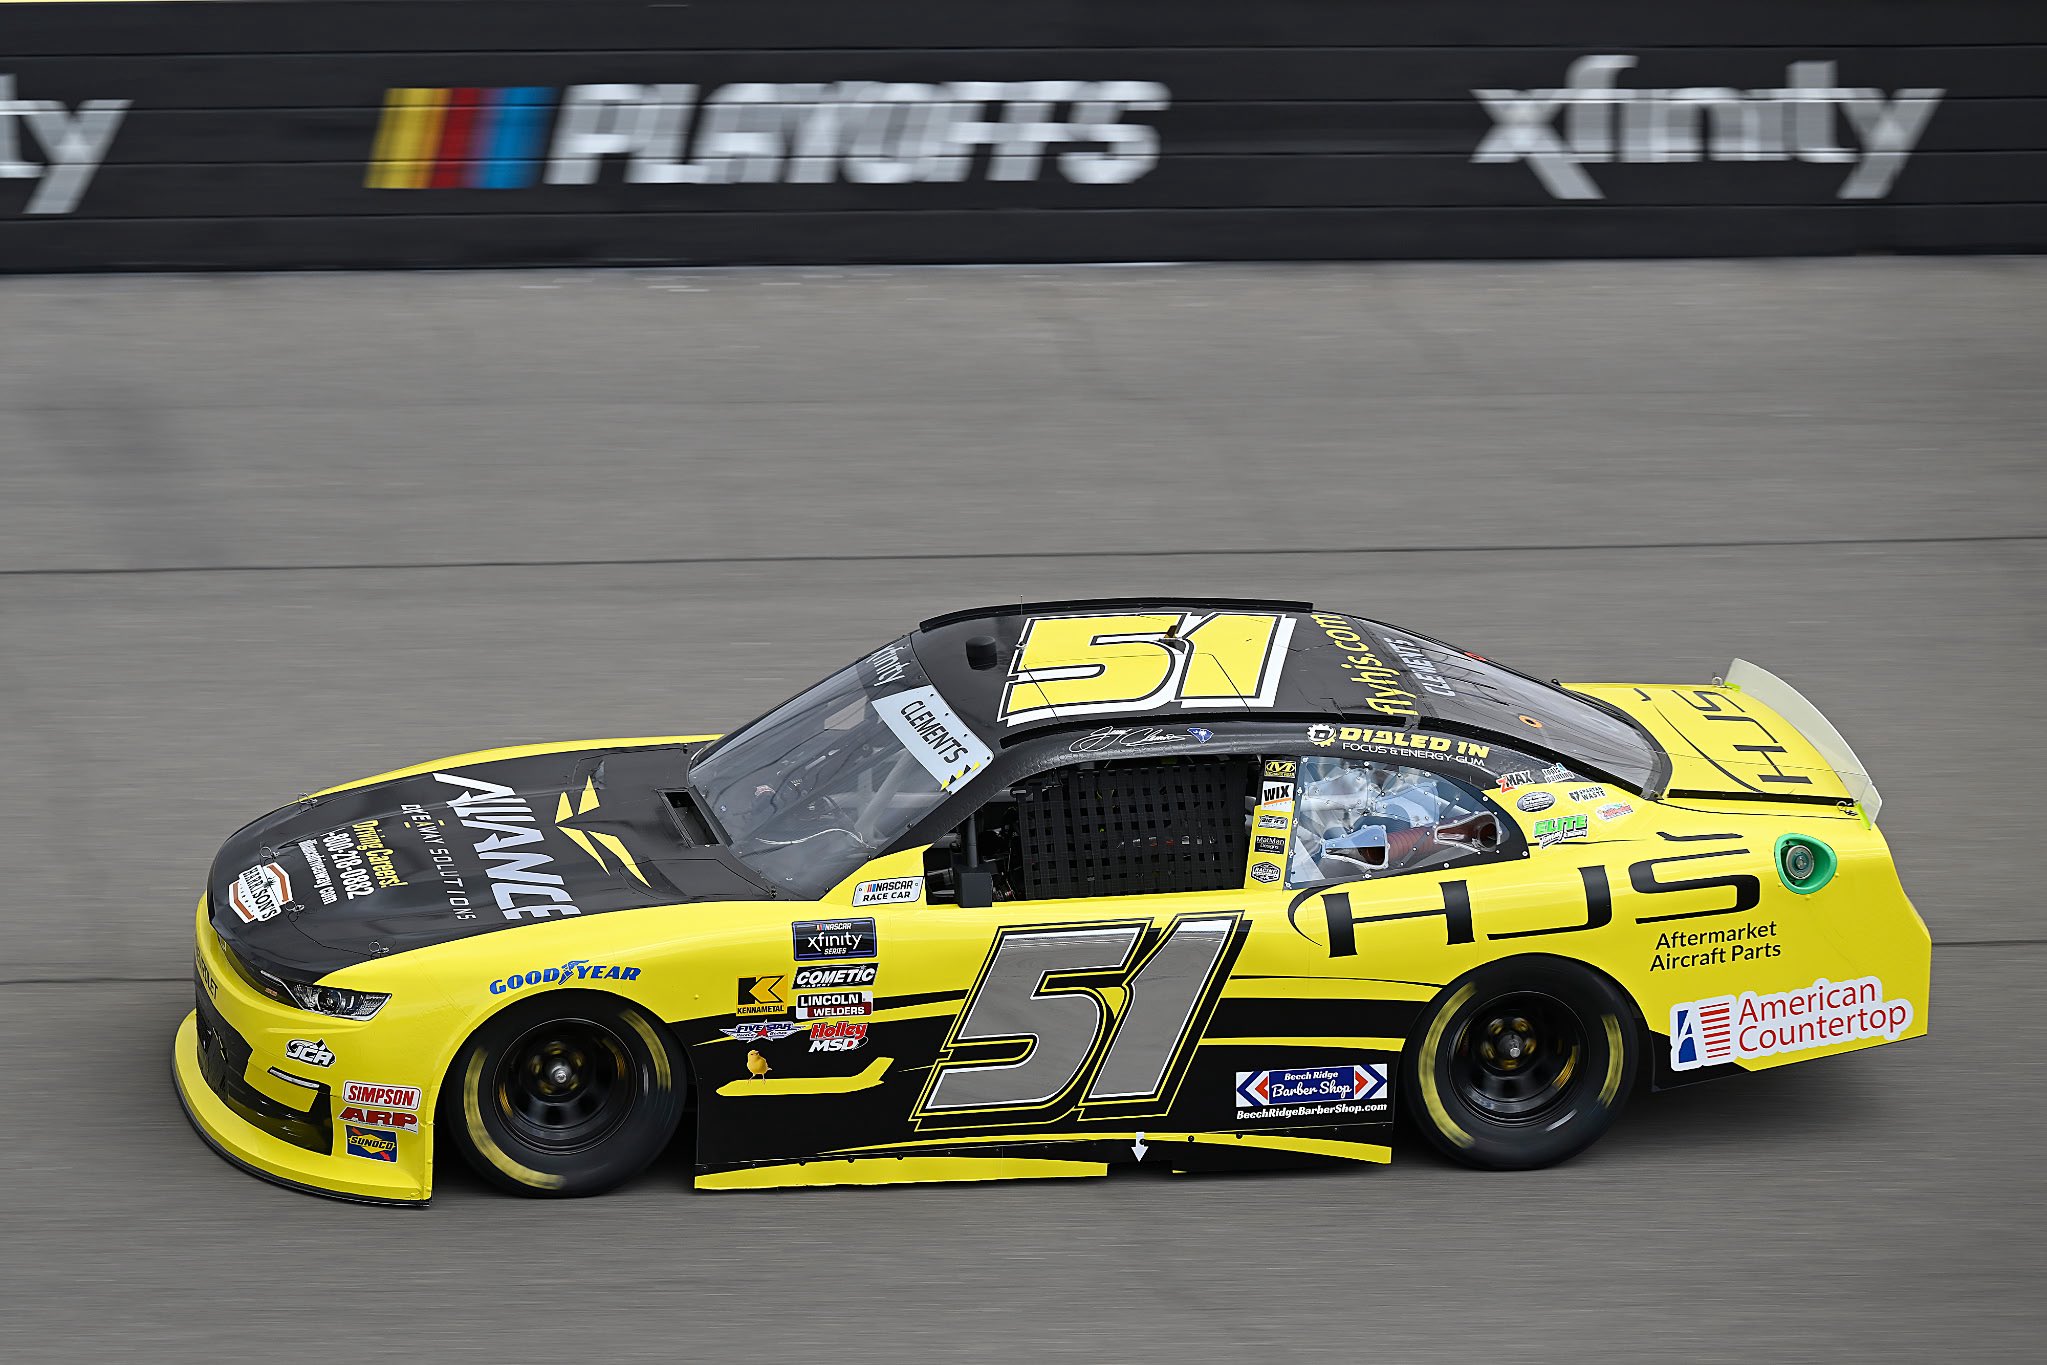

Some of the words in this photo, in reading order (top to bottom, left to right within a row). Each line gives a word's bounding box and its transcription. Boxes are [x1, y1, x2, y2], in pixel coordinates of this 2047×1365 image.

[545, 80, 1171, 184] PLAYOFFS
[1468, 54, 1946, 199] xfinity
[866, 644, 910, 686] xfinity
[997, 612, 1297, 727] 51
[1310, 614, 1419, 716] flyhjs.com
[1384, 637, 1456, 697] CLEMENTS
[900, 700, 969, 764] CLEMENTS
[1339, 727, 1452, 751] DIALED
[1457, 741, 1491, 759] IN
[1342, 743, 1387, 754] FOCUS
[1390, 747, 1398, 755] &
[1400, 749, 1452, 762] ENERGY
[1456, 755, 1485, 767] GUM
[1264, 785, 1290, 802] WIX
[1581, 790, 1606, 801] WASTE
[352, 819, 385, 851] Driving
[1534, 815, 1588, 837] ELITE
[432, 773, 581, 920] AVANCE
[366, 848, 408, 889] Careers!
[242, 867, 278, 920] HARRISON'S
[429, 848, 476, 920] SOLUTIONS
[875, 880, 913, 891] NASCAR
[863, 892, 888, 902] RACE
[891, 890, 911, 900] CAR
[1320, 846, 1762, 957] HJS
[825, 923, 852, 931] NASCAR
[1655, 920, 1777, 951] Aftermarket
[808, 931, 863, 952] xfinity
[824, 947, 847, 955] SERIES
[1650, 946, 1726, 972] Aircraft
[1731, 942, 1781, 962] Parts
[489, 960, 641, 994] GOODYEAR
[797, 966, 875, 985] COMETIC
[737, 1004, 784, 1015] KENNAMETAL
[801, 993, 859, 1007] LINCOLN
[813, 1006, 865, 1017] WELDERS
[1739, 982, 1876, 1026] American
[737, 1024, 763, 1034] FIVE
[810, 1021, 868, 1040] Holley
[909, 911, 1248, 1127] 51
[1739, 1005, 1907, 1052] Countertop
[808, 1037, 861, 1053] MSD
[1284, 1072, 1312, 1081] Beech
[1313, 1070, 1339, 1080] Ridge
[348, 1085, 414, 1107] SIMPSON
[1271, 1082, 1318, 1098] Barber
[1319, 1080, 1353, 1098] Shop
[340, 1106, 418, 1128] ARP
[1236, 1103, 1388, 1120] BeechRidgeBarberShop.com
[350, 1136, 394, 1150] SUNOCO
